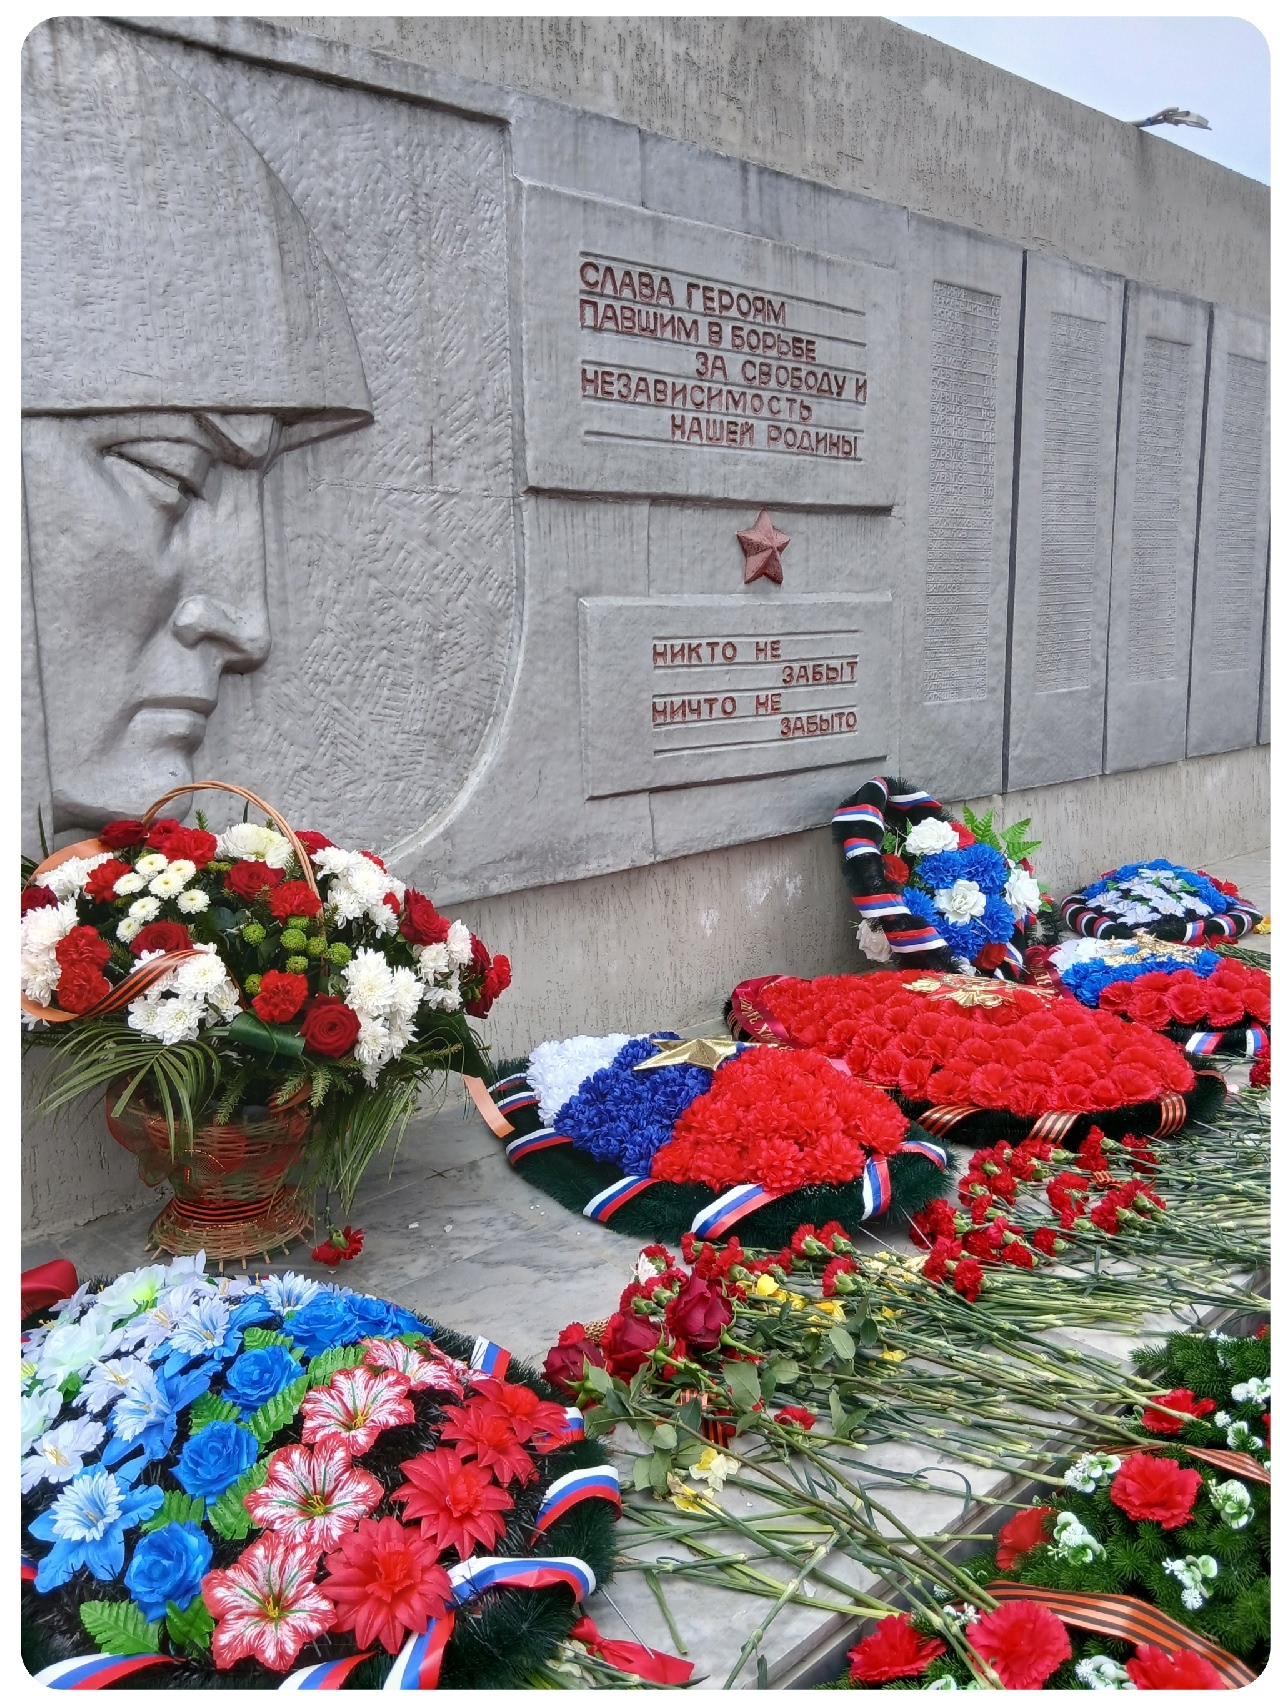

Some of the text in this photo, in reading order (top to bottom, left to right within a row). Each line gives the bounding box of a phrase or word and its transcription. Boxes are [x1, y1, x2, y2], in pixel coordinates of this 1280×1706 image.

[579, 261, 787, 326] СЛАВА ГЕРОЯМ
[579, 299, 816, 363] ПАВШИМ В БОРЬБЕ
[581, 368, 813, 423] НЕЗАВИСИМОСТЬ
[696, 351, 868, 402] ЗА СВОБОДУ И
[671, 414, 858, 458] НАШЕЙ РОДИНЫ
[652, 640, 782, 665] НИКТО НЕ
[782, 661, 858, 686] ЗАБЫТ
[652, 693, 783, 723] НИЧТО НЕ
[780, 711, 858, 738] ЗАБЫТО
